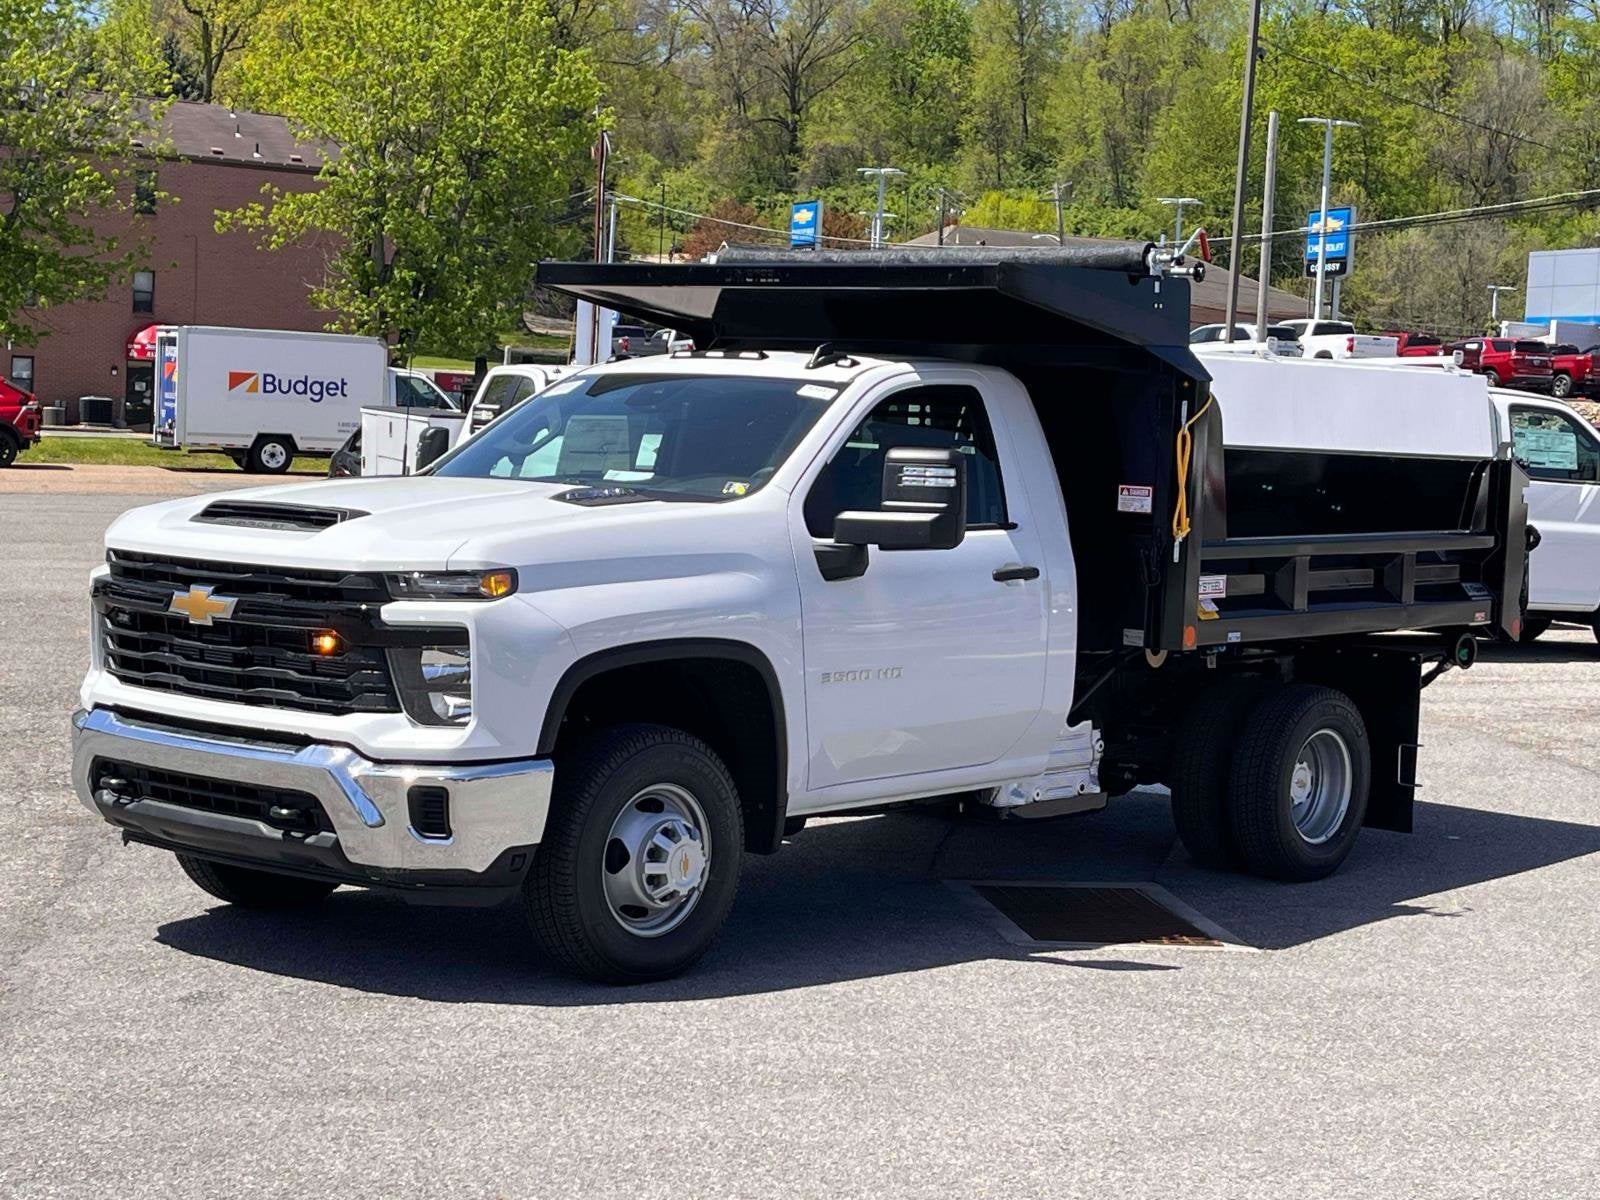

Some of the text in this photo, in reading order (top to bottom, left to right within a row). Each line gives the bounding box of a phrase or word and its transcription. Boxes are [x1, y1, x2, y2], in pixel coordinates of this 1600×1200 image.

[262, 373, 348, 403] Budget
[820, 666, 904, 684] 3500 HD
